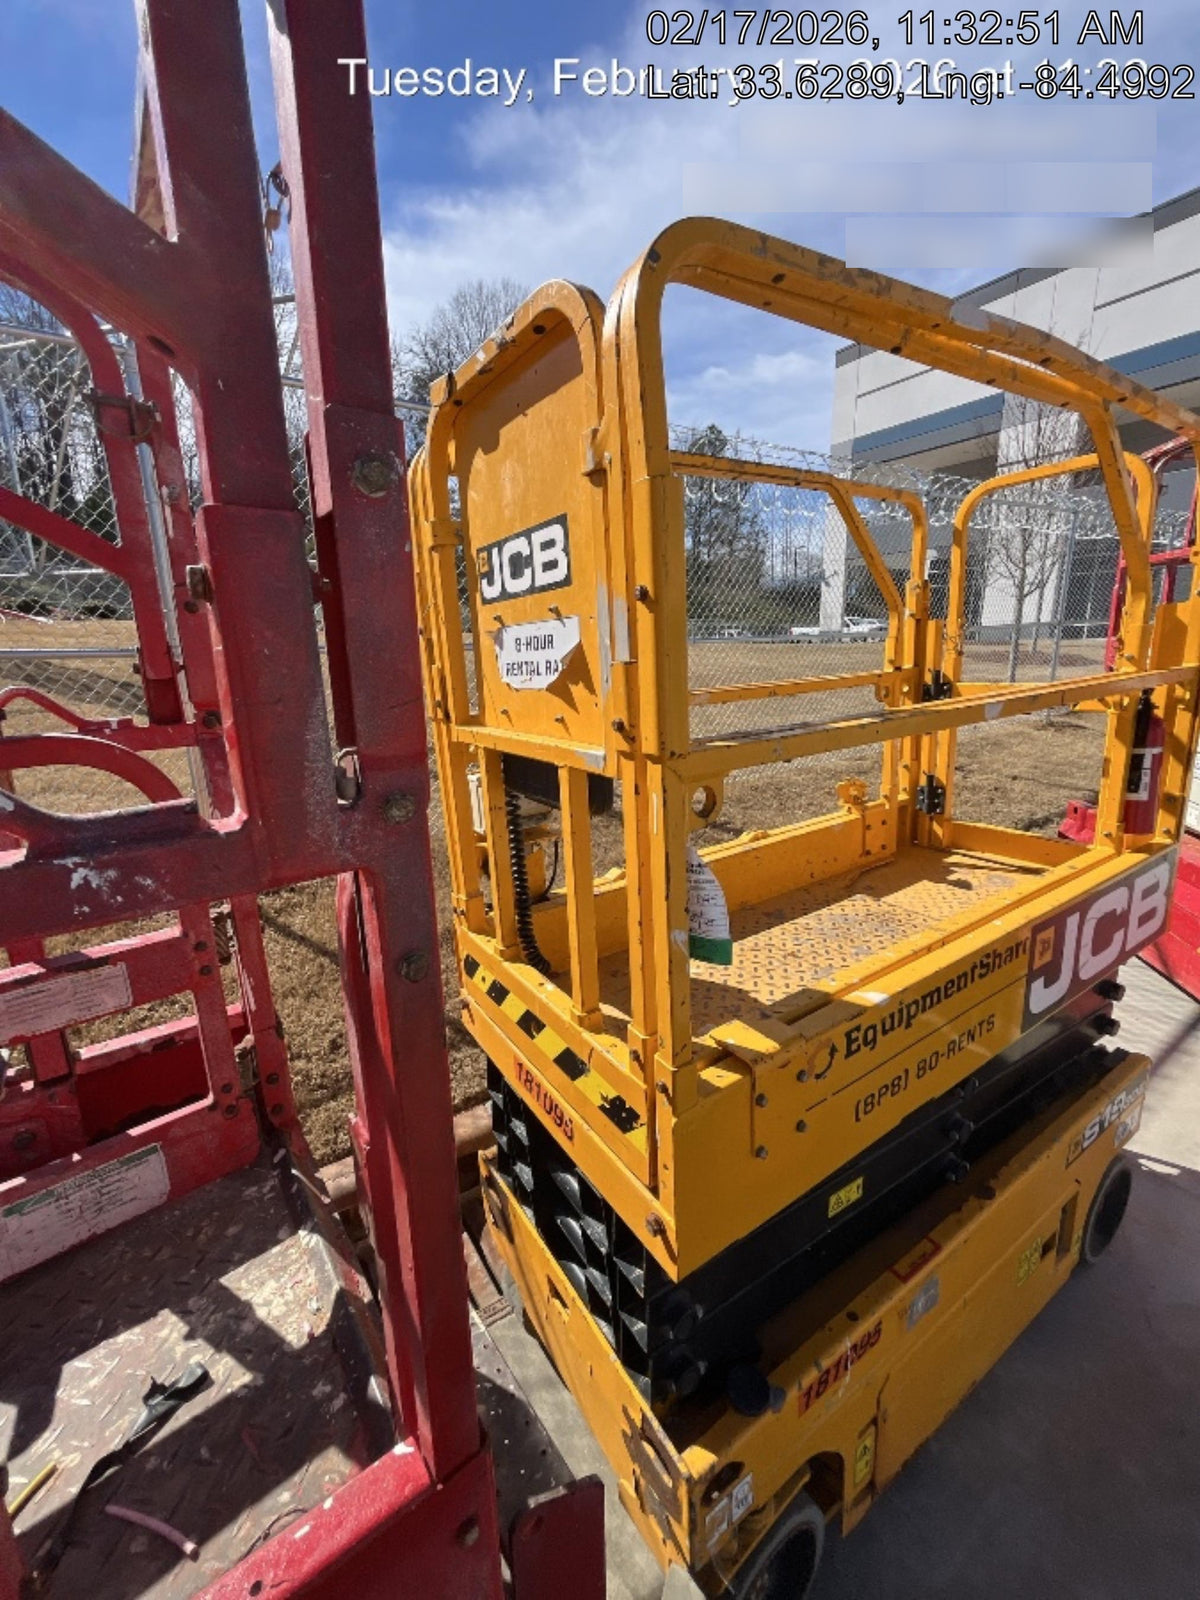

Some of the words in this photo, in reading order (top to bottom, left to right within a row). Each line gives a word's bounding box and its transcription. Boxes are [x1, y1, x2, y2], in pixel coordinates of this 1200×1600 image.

[481, 523, 569, 600] JCB
[505, 660, 542, 677] RENTAL
[1029, 862, 1170, 1014] JCB
